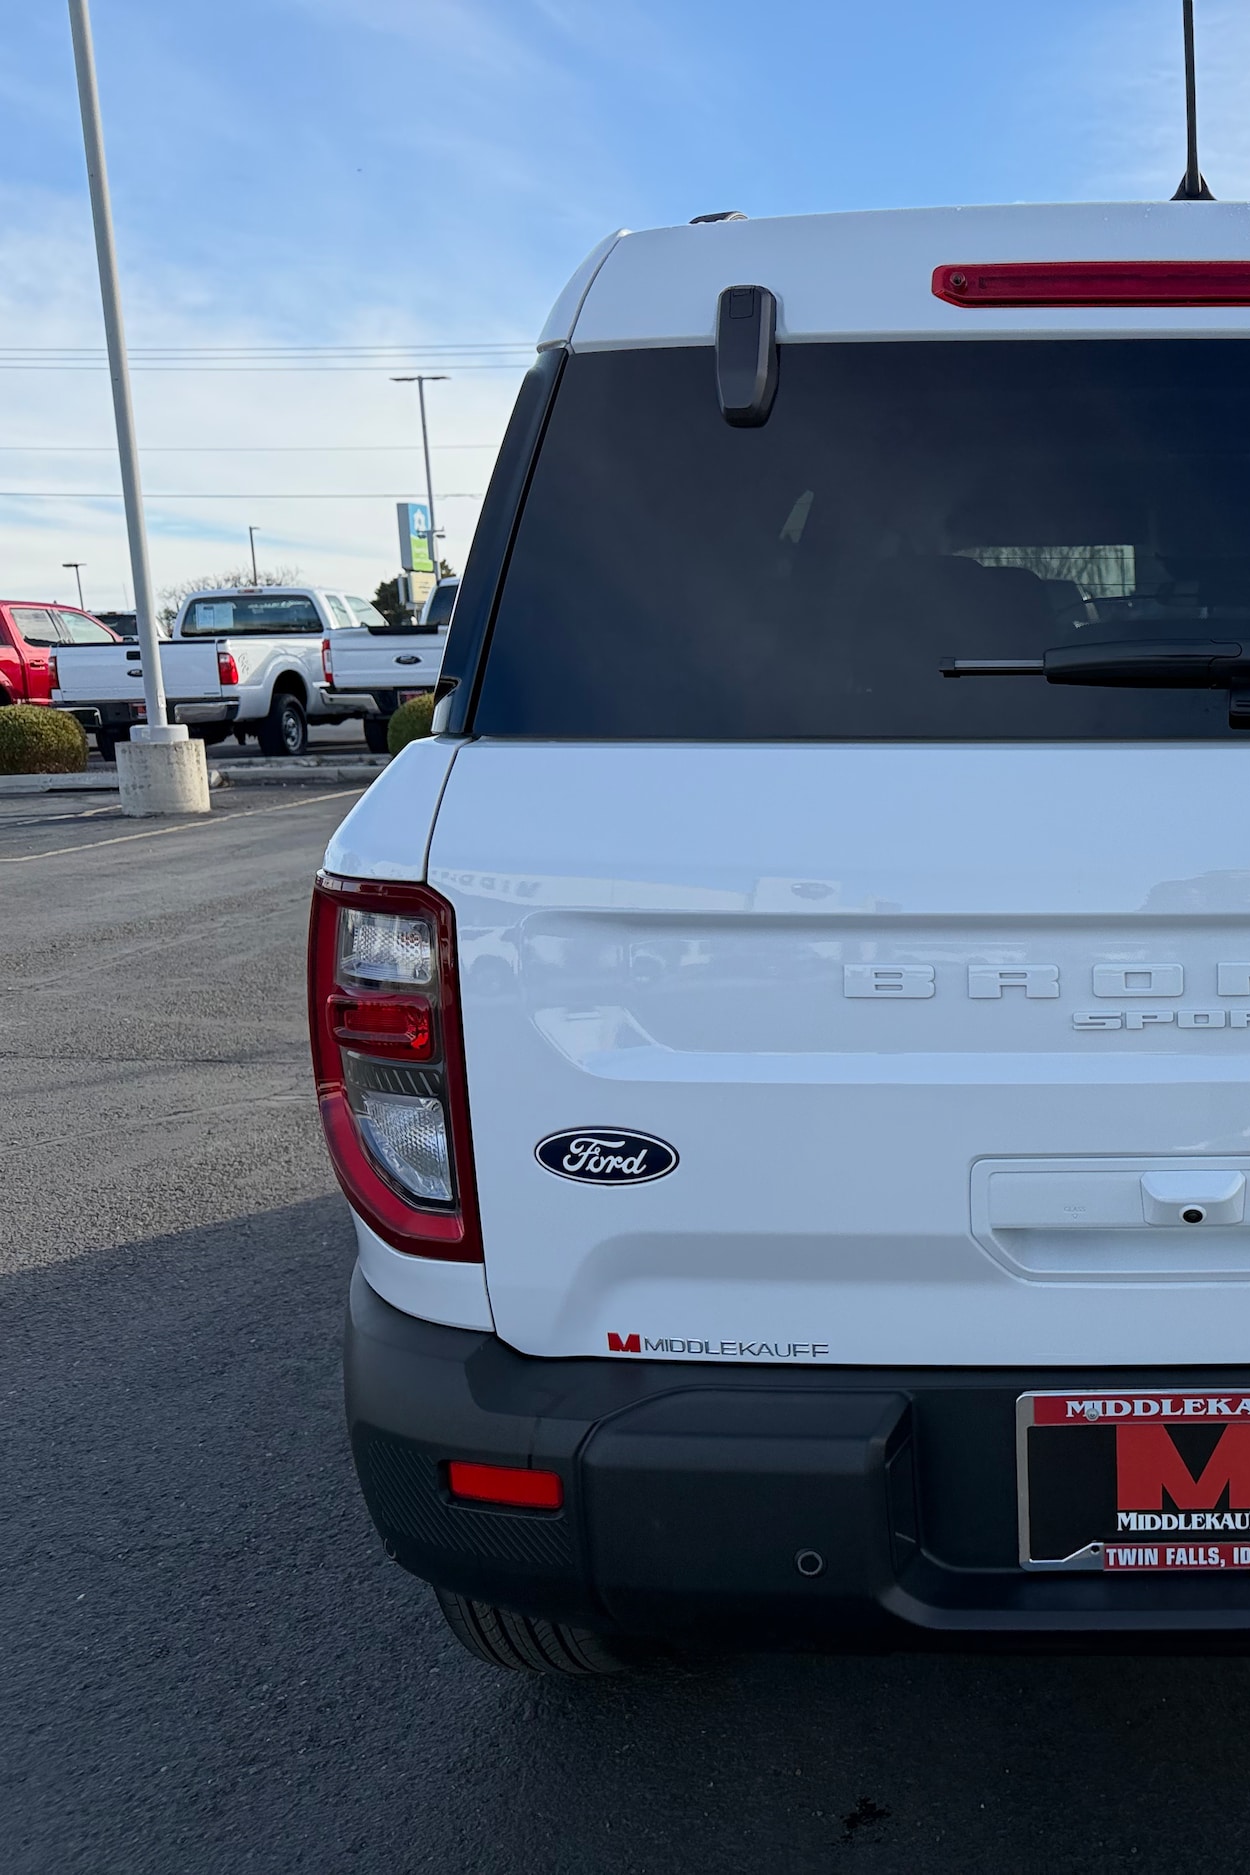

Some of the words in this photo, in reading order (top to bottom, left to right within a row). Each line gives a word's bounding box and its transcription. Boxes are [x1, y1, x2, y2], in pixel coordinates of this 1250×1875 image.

[562, 1137, 649, 1175] Ford
[644, 1336, 829, 1358] MIDDLEKAUFF
[1106, 1548, 1158, 1567] TWIN
[1165, 1547, 1226, 1568] FALLS,
